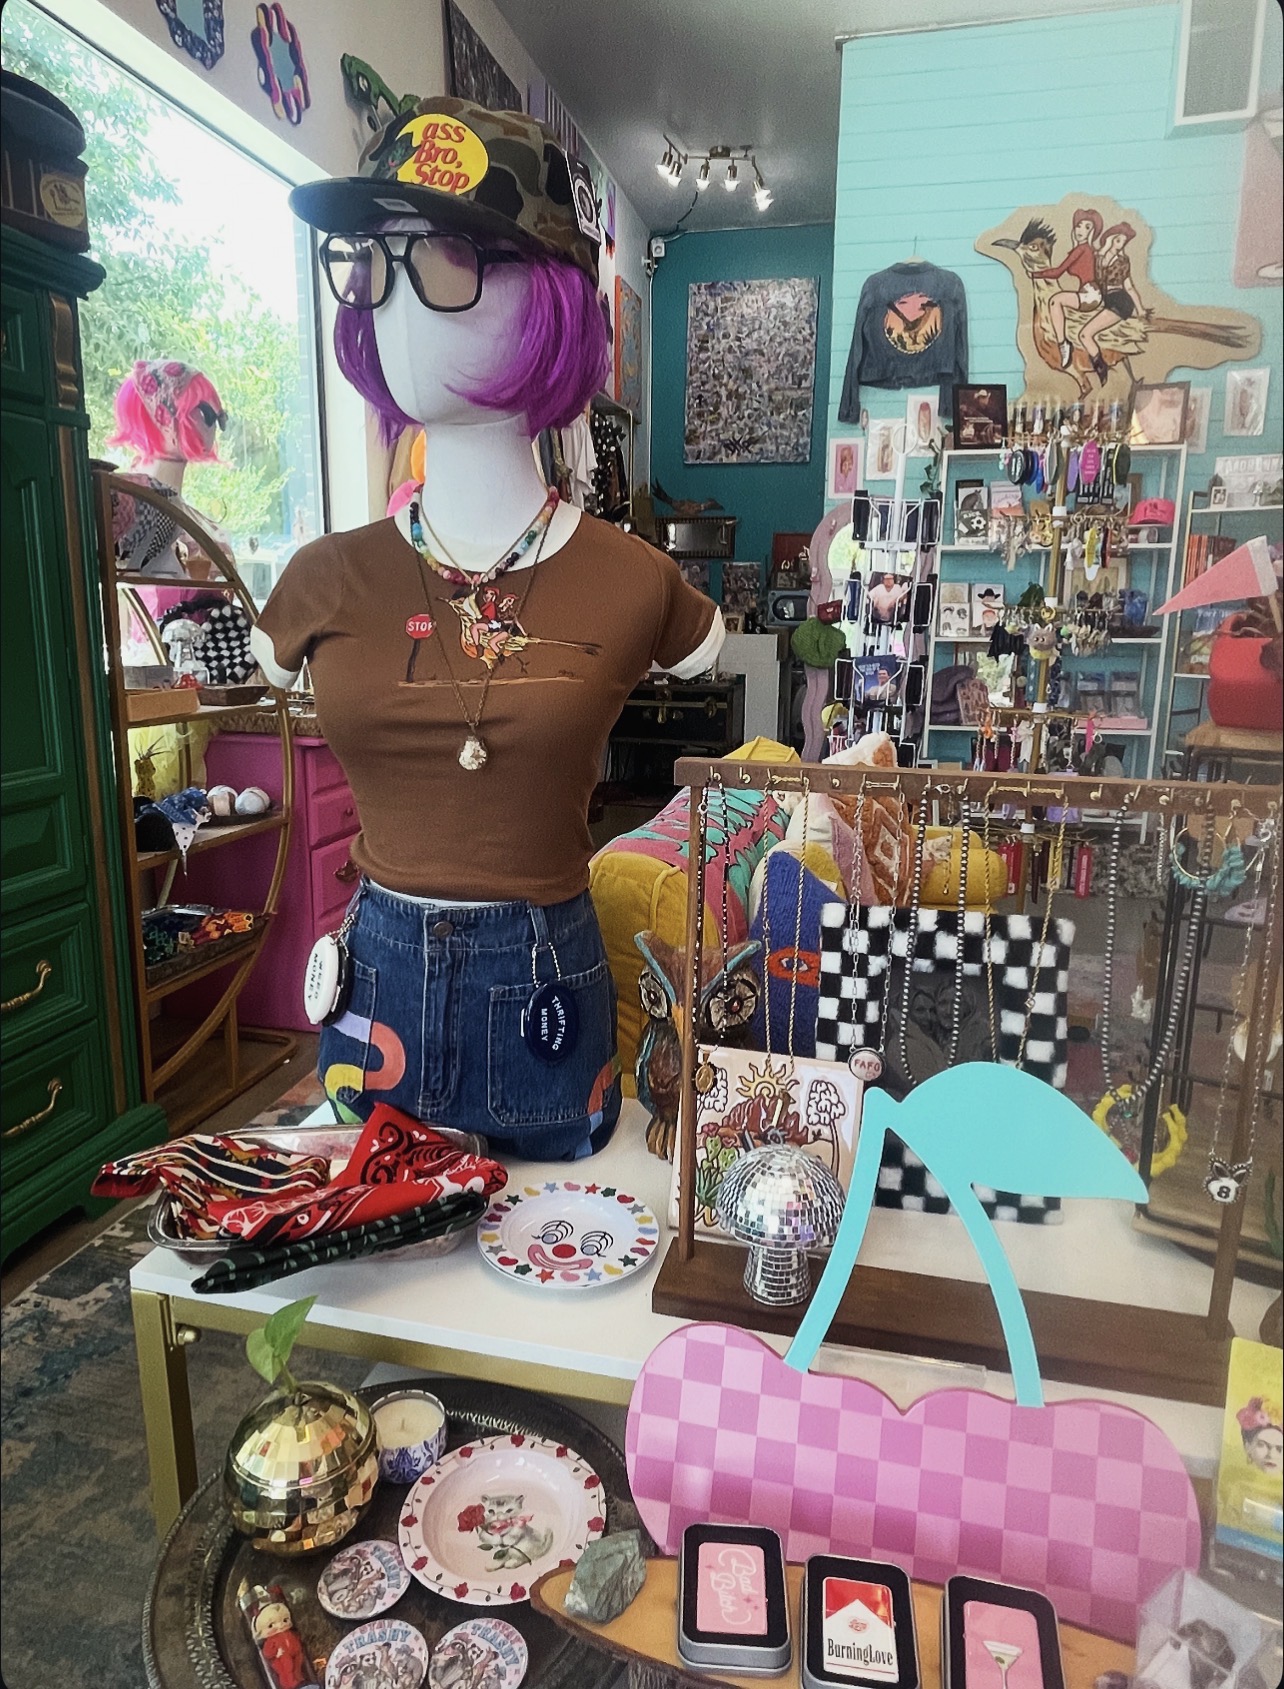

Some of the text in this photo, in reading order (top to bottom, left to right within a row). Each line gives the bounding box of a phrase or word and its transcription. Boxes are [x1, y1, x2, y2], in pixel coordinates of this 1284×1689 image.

[422, 122, 466, 143] ass
[415, 163, 470, 194] Stop
[308, 953, 319, 1001] MONEY
[551, 995, 567, 1051] THRIFTING
[854, 1058, 881, 1072] FAFO
[1217, 1186, 1231, 1199] 8
[718, 1548, 759, 1595] Bad
[342, 1628, 411, 1653] TRASHY
